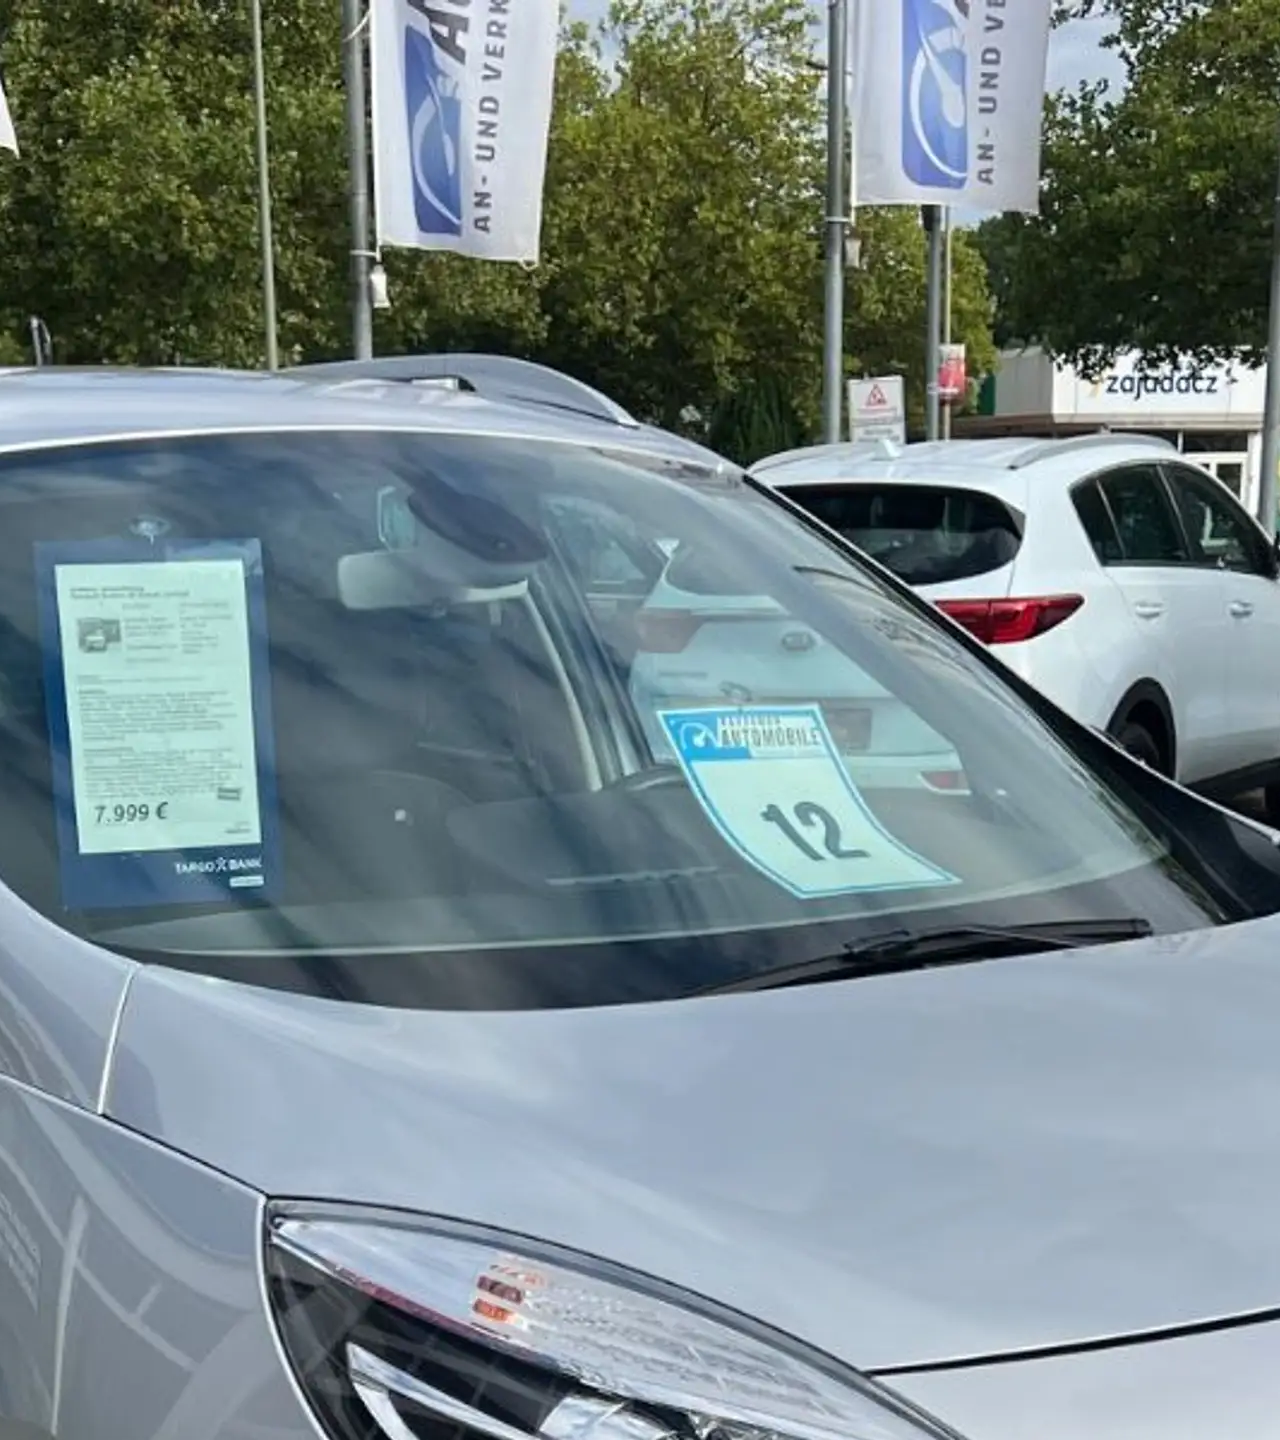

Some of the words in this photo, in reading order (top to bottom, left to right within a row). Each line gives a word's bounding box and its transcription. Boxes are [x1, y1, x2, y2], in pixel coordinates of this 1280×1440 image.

[978, 47, 1001, 114] UND
[475, 95, 500, 163] UND
[721, 726, 820, 747] AUTOMOBILE
[94, 803, 150, 824] 7.999
[155, 801, 169, 821] €
[760, 801, 872, 861] 12
